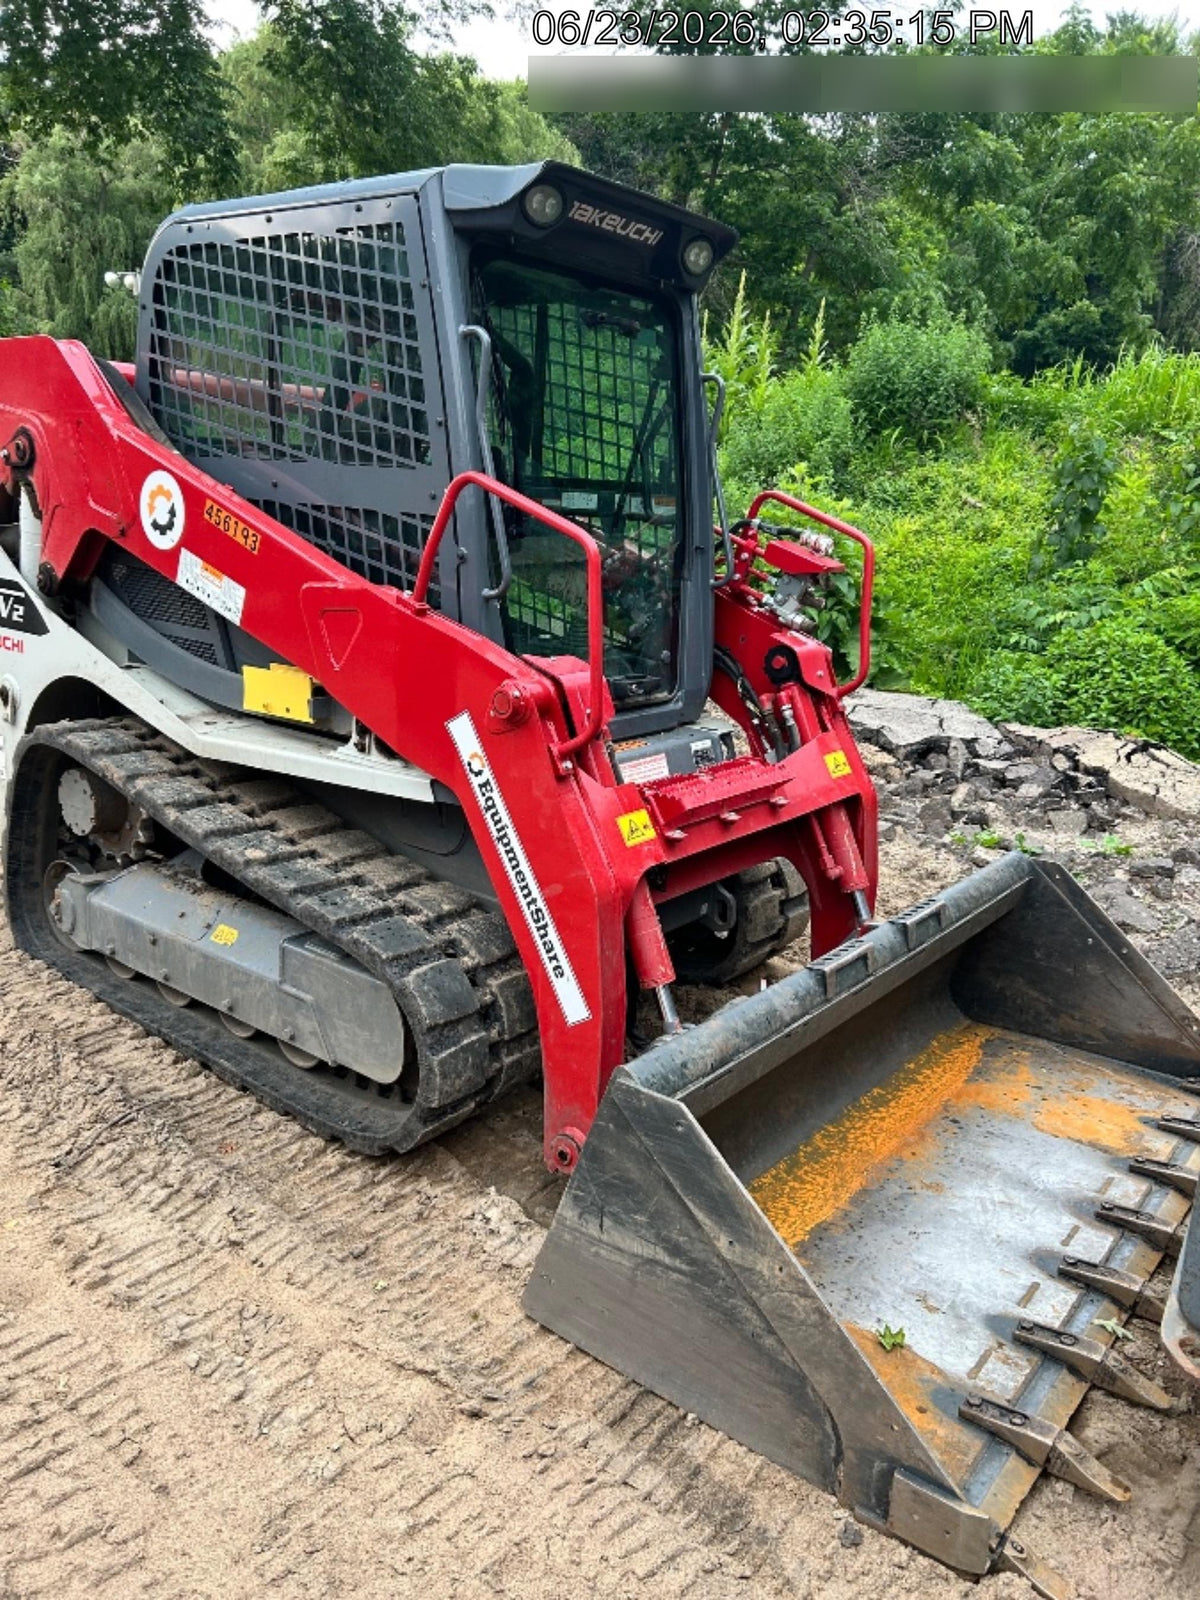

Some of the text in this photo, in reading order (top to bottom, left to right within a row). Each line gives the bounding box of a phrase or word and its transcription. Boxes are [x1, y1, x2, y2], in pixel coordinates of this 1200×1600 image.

[205, 504, 259, 552] 456193
[0, 635, 24, 653] CHI
[478, 777, 565, 979] EquipmentShare
